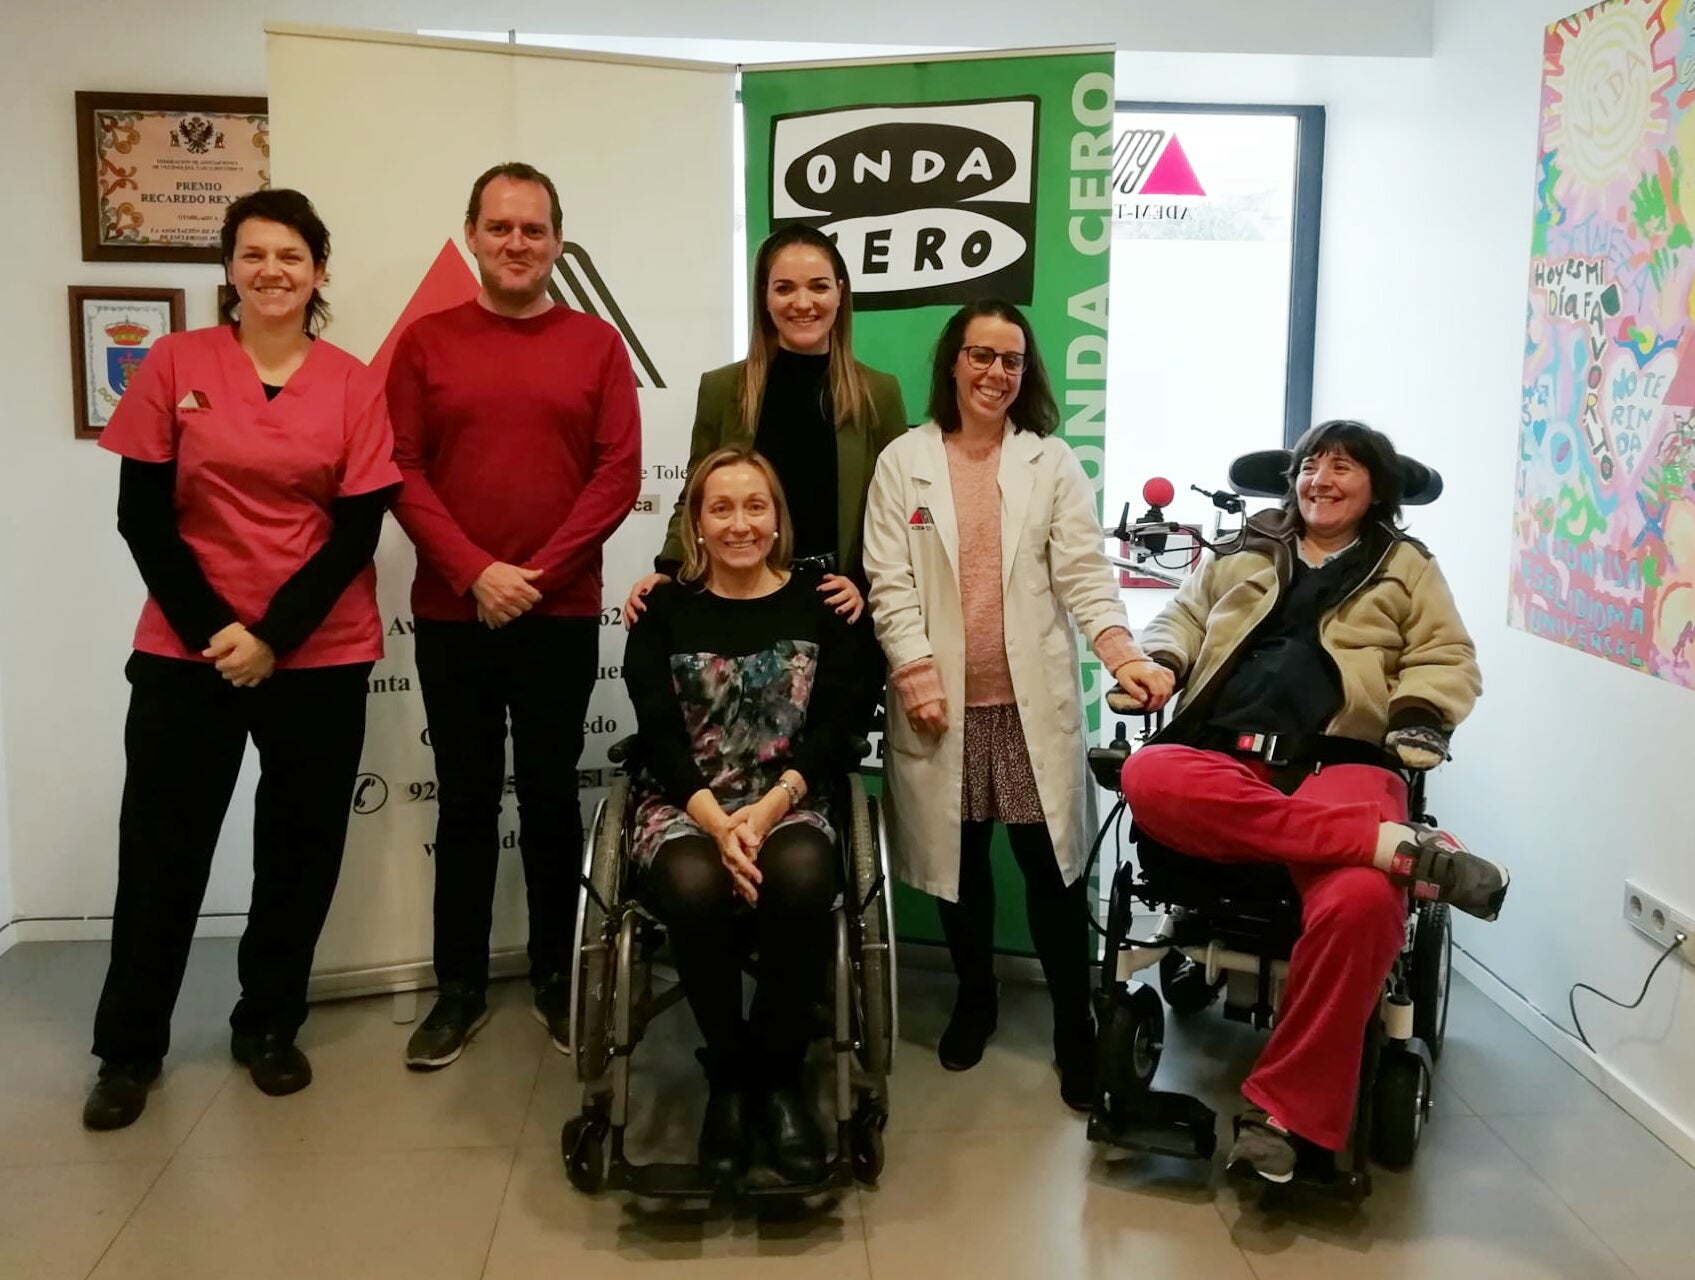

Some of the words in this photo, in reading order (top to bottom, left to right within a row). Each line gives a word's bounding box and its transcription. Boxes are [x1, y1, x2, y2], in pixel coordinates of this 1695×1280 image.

[806, 147, 993, 194] ONDA
[1069, 71, 1114, 256] CERO
[176, 181, 222, 191] PREMIO
[141, 193, 205, 204] RECAREDO
[829, 226, 992, 275] ERO
[1535, 263, 1564, 287] HOY
[653, 465, 687, 480] Tole
[409, 781, 436, 800] 92
